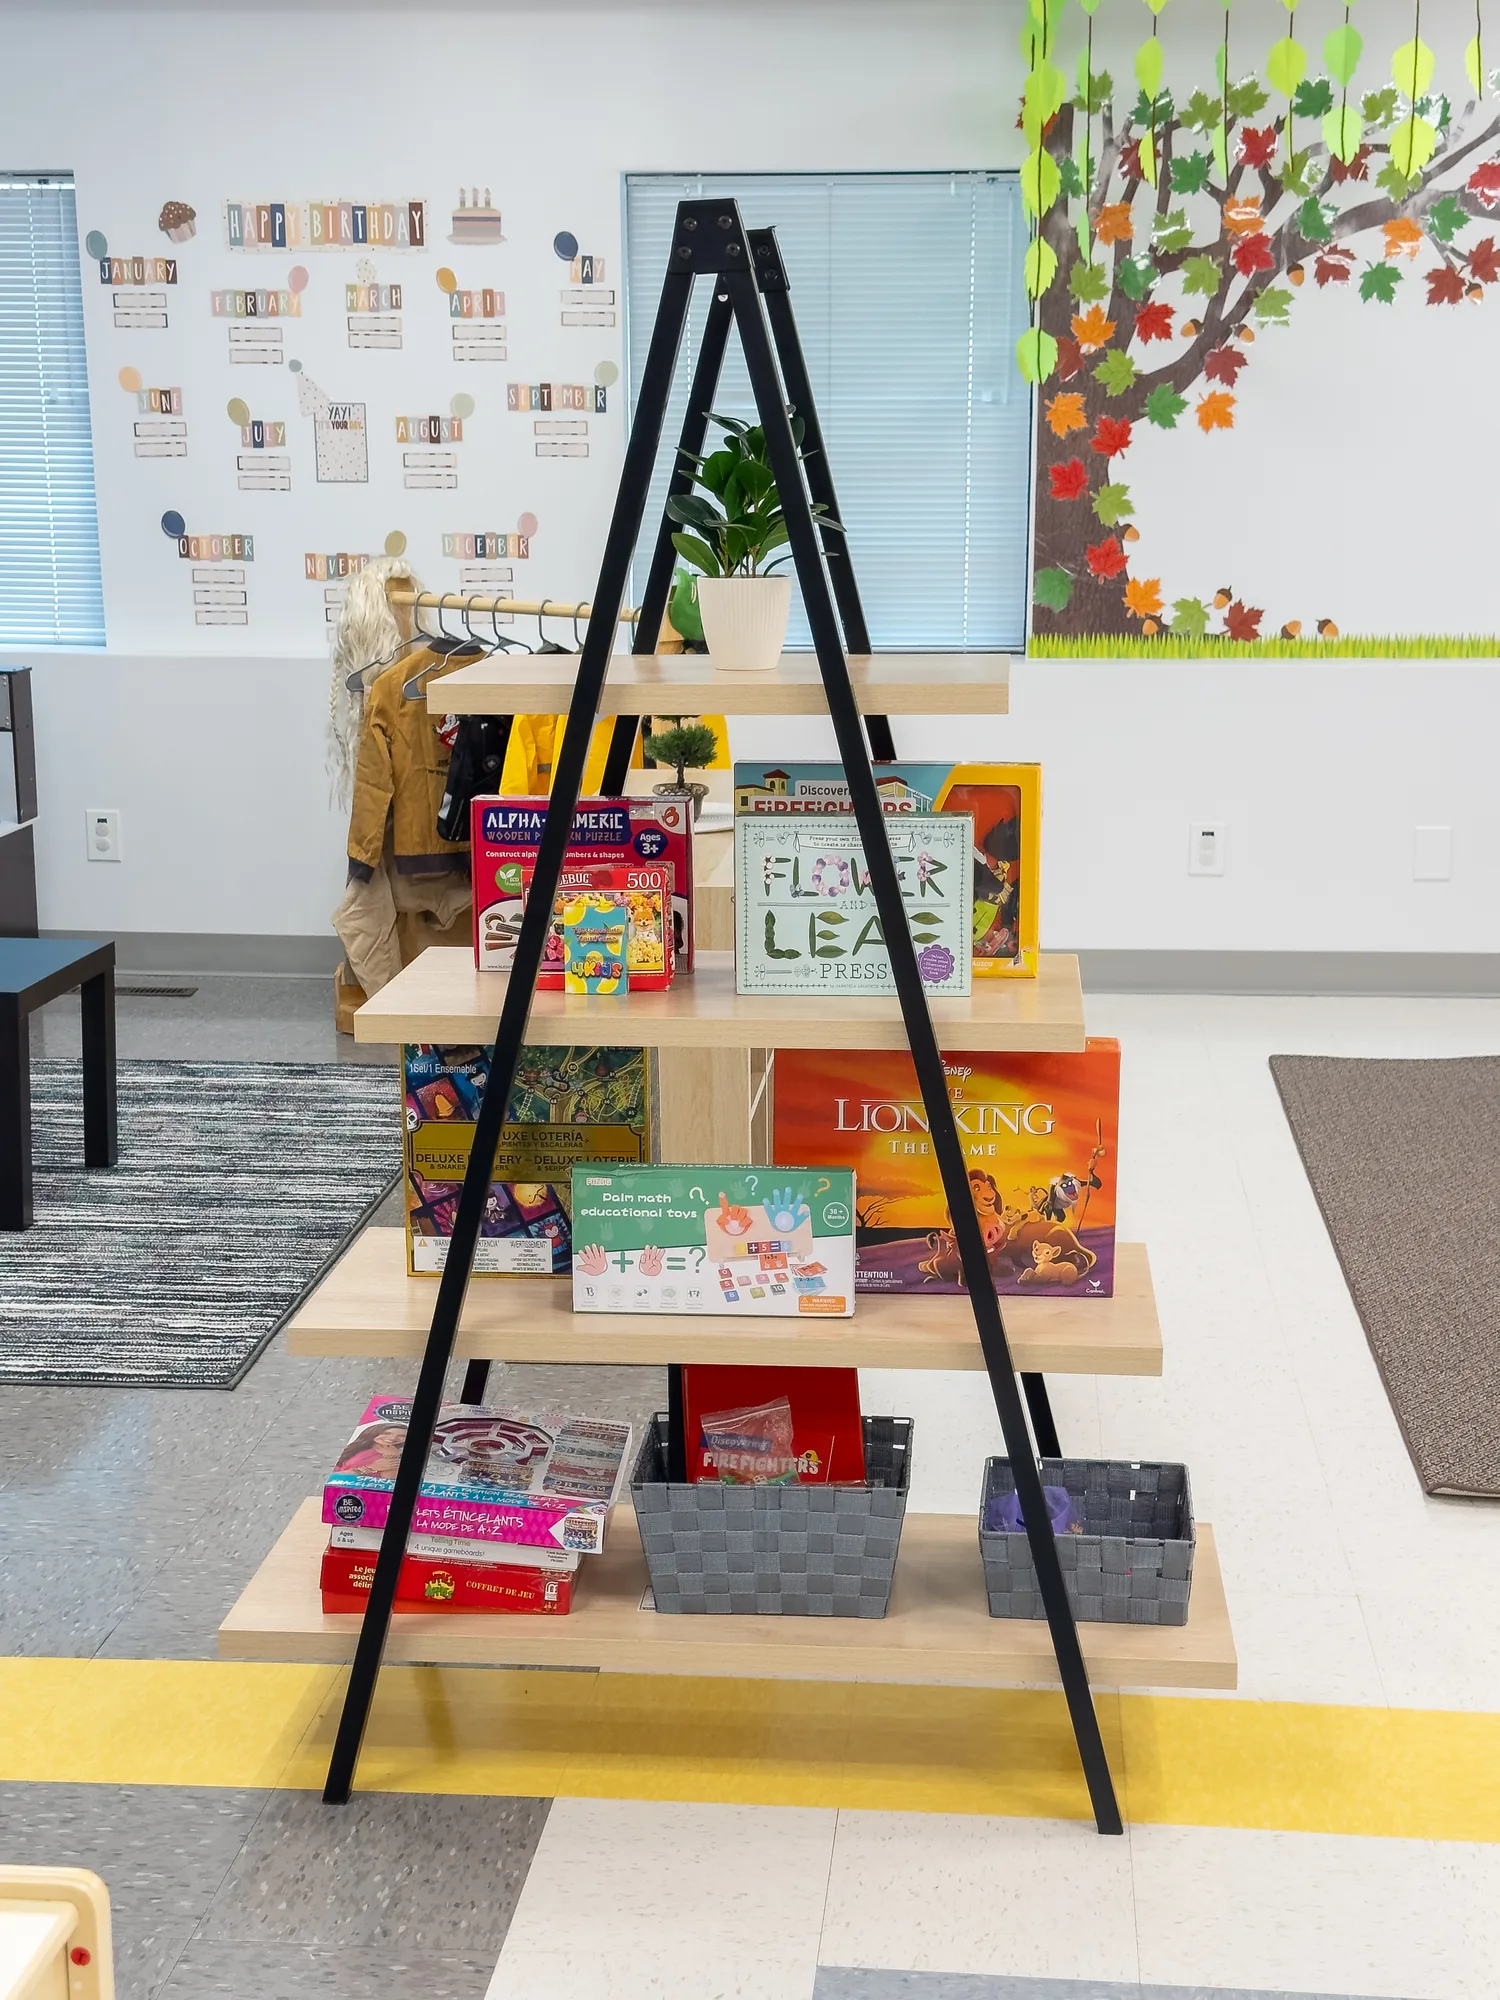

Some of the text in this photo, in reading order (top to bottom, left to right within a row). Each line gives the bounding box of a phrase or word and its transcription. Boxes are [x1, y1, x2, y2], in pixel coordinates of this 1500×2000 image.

[228, 208, 422, 242] HAPPY BIRTHDAY
[101, 260, 177, 280] JANUARY
[571, 258, 604, 279] MAY
[214, 293, 302, 314] FEBRUARY
[346, 288, 401, 308] MARCH
[451, 292, 504, 312] APRIL
[141, 390, 180, 411] JUNE
[508, 387, 605, 408] SEPTEMBER
[331, 420, 348, 430] YOUR
[397, 420, 461, 439] AUGUST
[242, 425, 285, 444] JULY
[179, 537, 254, 557] OCTOBER
[444, 536, 528, 556] DECEMBER
[305, 556, 368, 575] NOVEMB
[800, 784, 851, 796] Discover
[486, 831, 531, 841] WOODEN
[585, 831, 623, 842] PUZZLE
[639, 833, 662, 843] Ages
[485, 850, 521, 859] Construct
[565, 851, 591, 859] umbers
[592, 851, 599, 859] &
[599, 852, 625, 861] shapes
[642, 843, 659, 855] 3+
[626, 872, 662, 889] 500
[839, 900, 868, 910] AND
[819, 963, 888, 980] PRESS
[833, 1098, 1056, 1136] LION KING
[502, 1129, 583, 1141] UXE LOTERÍA
[888, 1140, 930, 1155] THE
[416, 1153, 464, 1164] DELUXE
[534, 1155, 582, 1164] DELUXE
[602, 1192, 672, 1203] Palm math
[580, 1207, 698, 1219] educational toys
[710, 1435, 770, 1451] Discovering
[461, 1487, 500, 1496] FASHION
[503, 1491, 560, 1502] BRACELETS
[496, 1496, 523, 1505] MODE
[443, 1505, 524, 1528] ÉTINCELANTS
[416, 1519, 428, 1529] LA
[430, 1521, 459, 1531] MODE
[461, 1523, 475, 1533] DE
[339, 1530, 353, 1538] Ages
[414, 1543, 420, 1551] 4
[421, 1545, 442, 1555] unique
[453, 1537, 472, 1547] Time
[354, 1564, 376, 1574] Le jeu
[465, 1580, 504, 1594] COFFRET
[505, 1586, 518, 1597] DE
[518, 1589, 535, 1600] JEU
